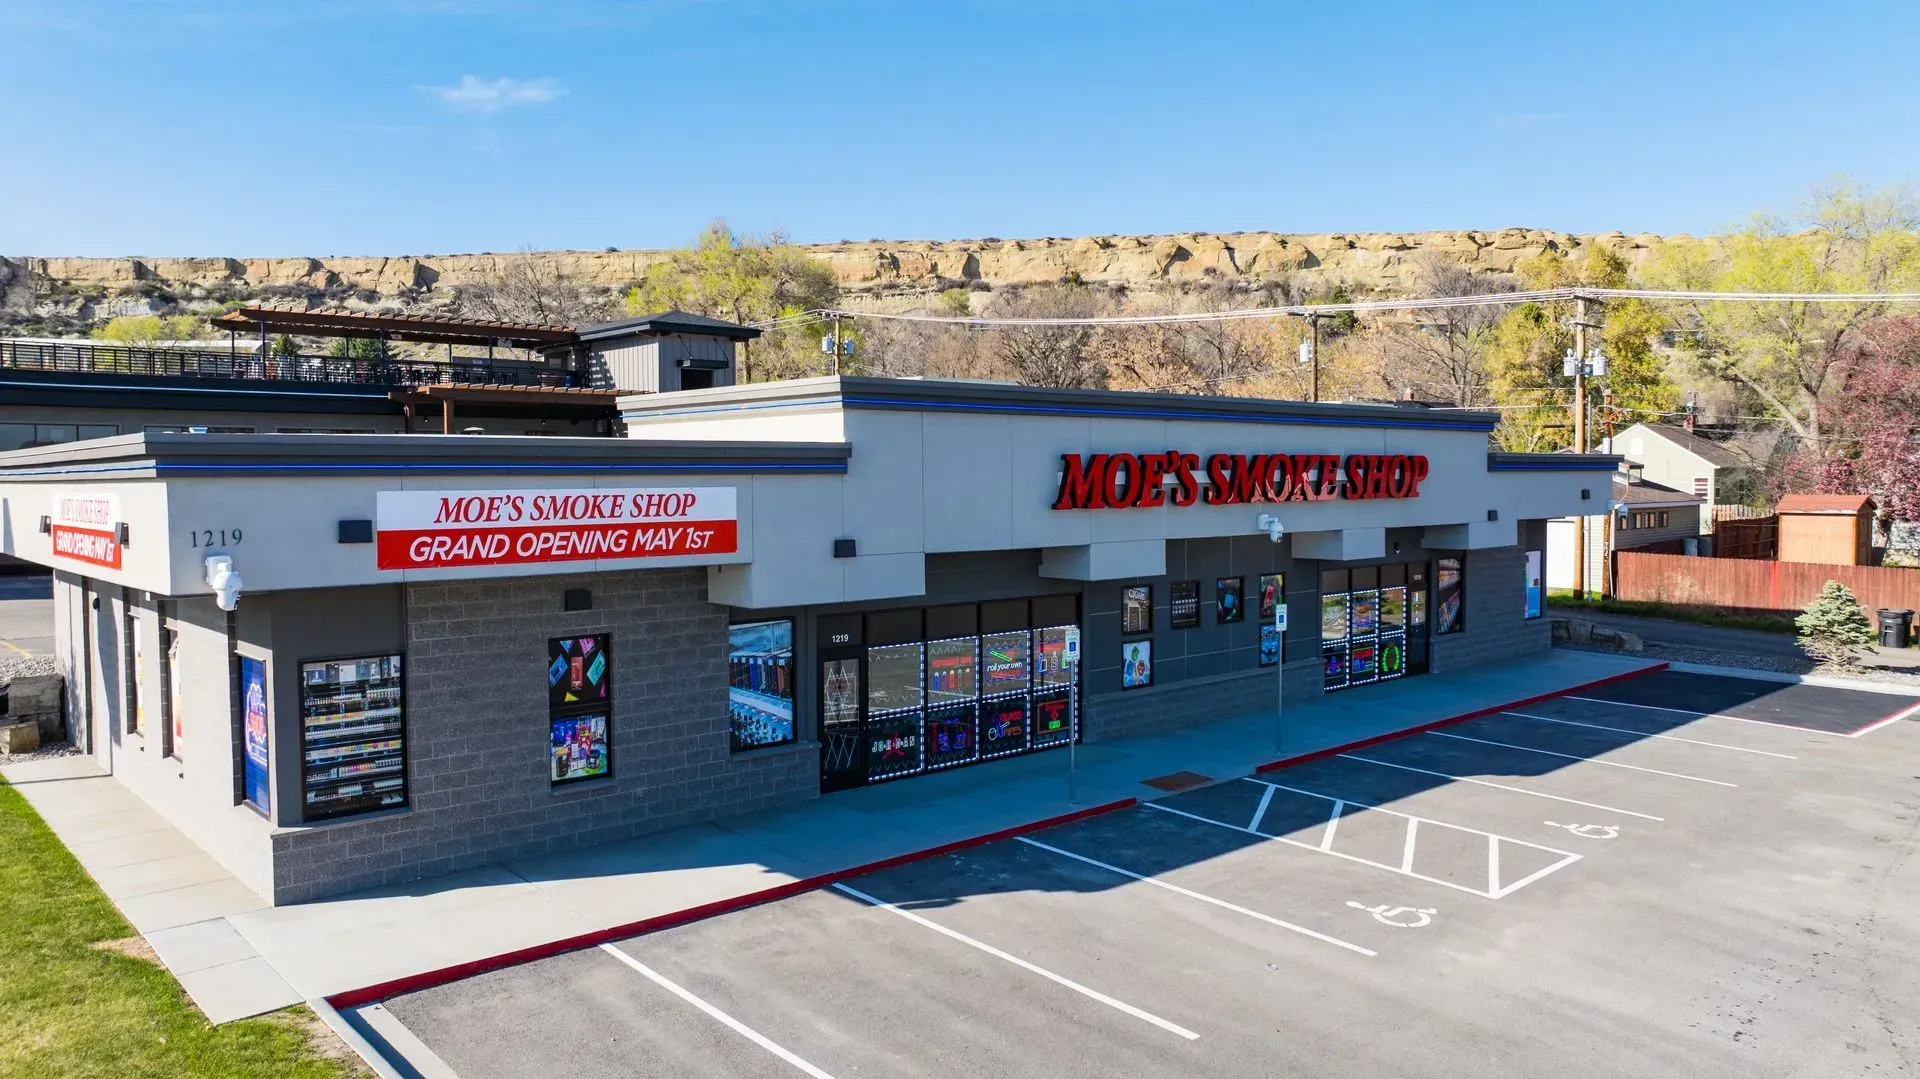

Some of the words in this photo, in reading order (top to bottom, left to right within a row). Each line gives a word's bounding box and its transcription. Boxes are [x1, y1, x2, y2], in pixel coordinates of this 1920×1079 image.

[1051, 450, 1200, 511] MOE'S
[1203, 453, 1341, 506] SMOKE
[1345, 454, 1430, 500] SHOP
[433, 495, 525, 524] MOE'S
[530, 494, 625, 521] SMOKE
[629, 493, 697, 519] SHOP
[56, 530, 73, 554] GRAND
[191, 528, 243, 548] 1219
[409, 533, 511, 562] GRAND
[516, 529, 629, 558] OPENING
[631, 527, 684, 552] MAY
[685, 527, 714, 549] 1ST
[832, 634, 849, 643] 1219
